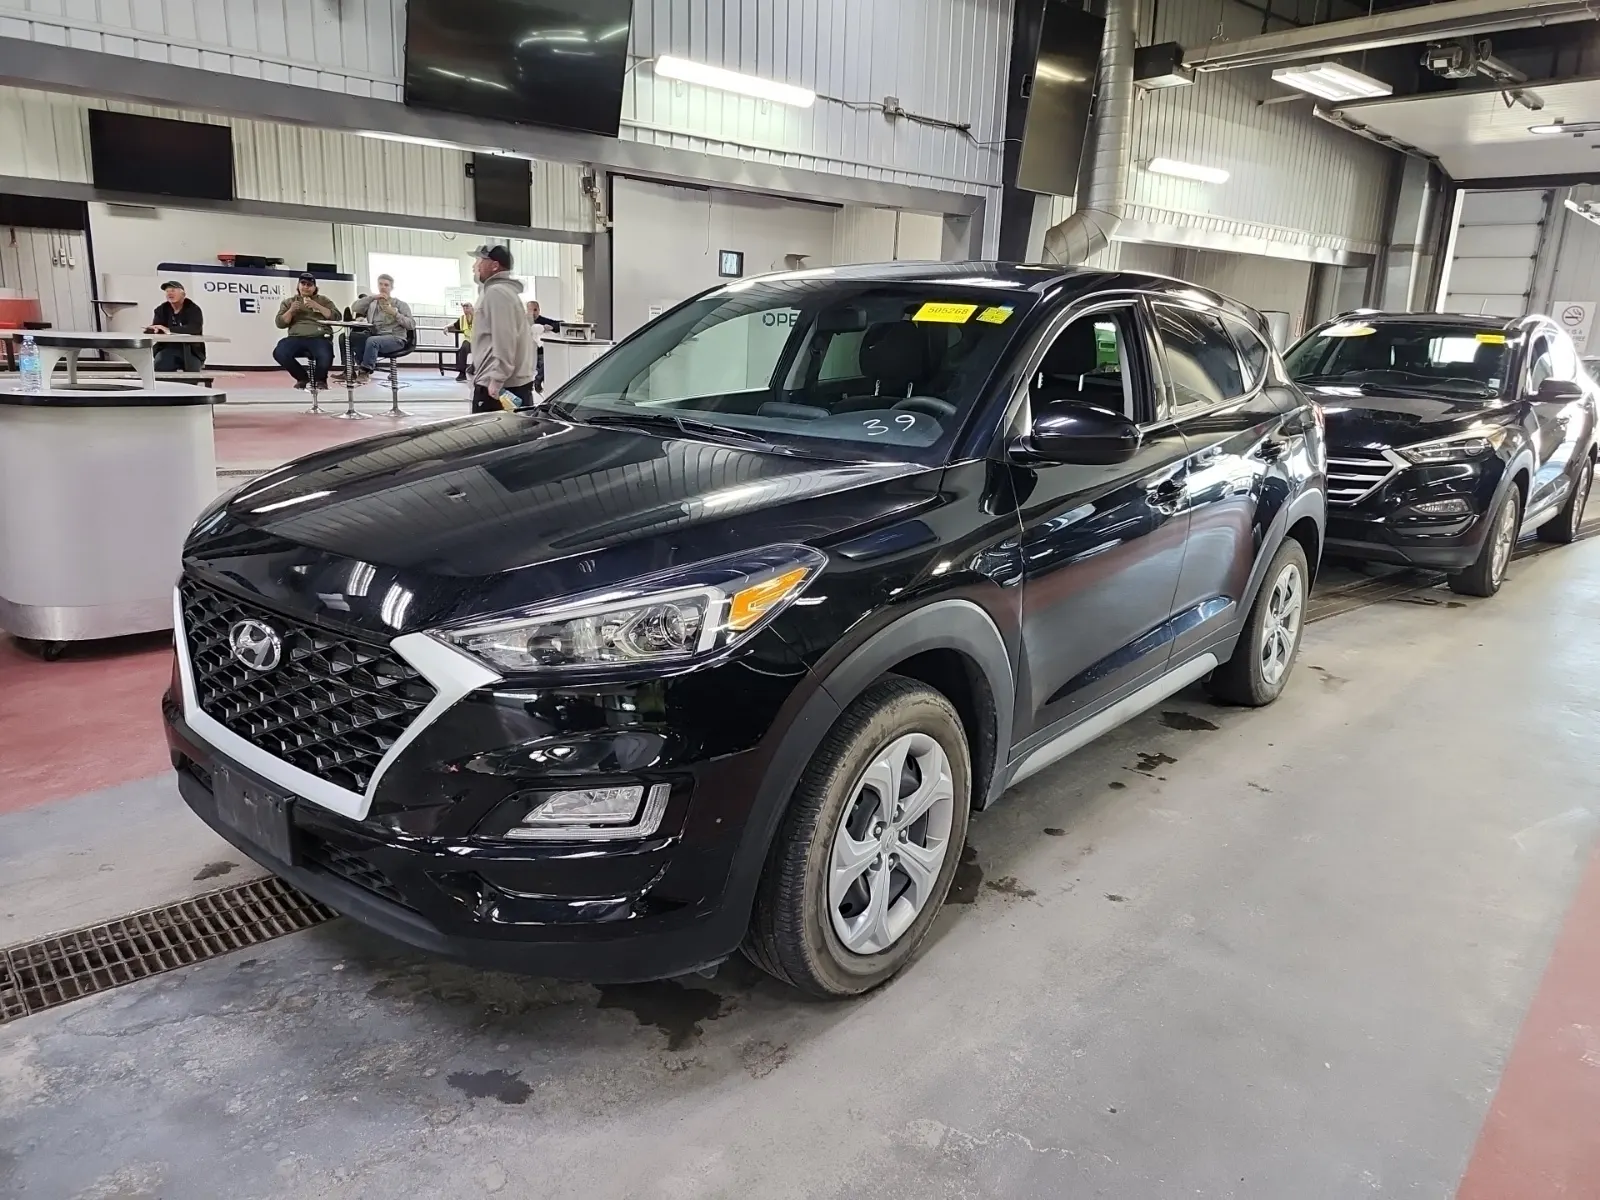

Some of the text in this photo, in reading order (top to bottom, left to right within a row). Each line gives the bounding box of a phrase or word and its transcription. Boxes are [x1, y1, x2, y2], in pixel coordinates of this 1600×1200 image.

[927, 306, 969, 315] 505268
[762, 312, 798, 327] OPE
[862, 414, 916, 436] 39
